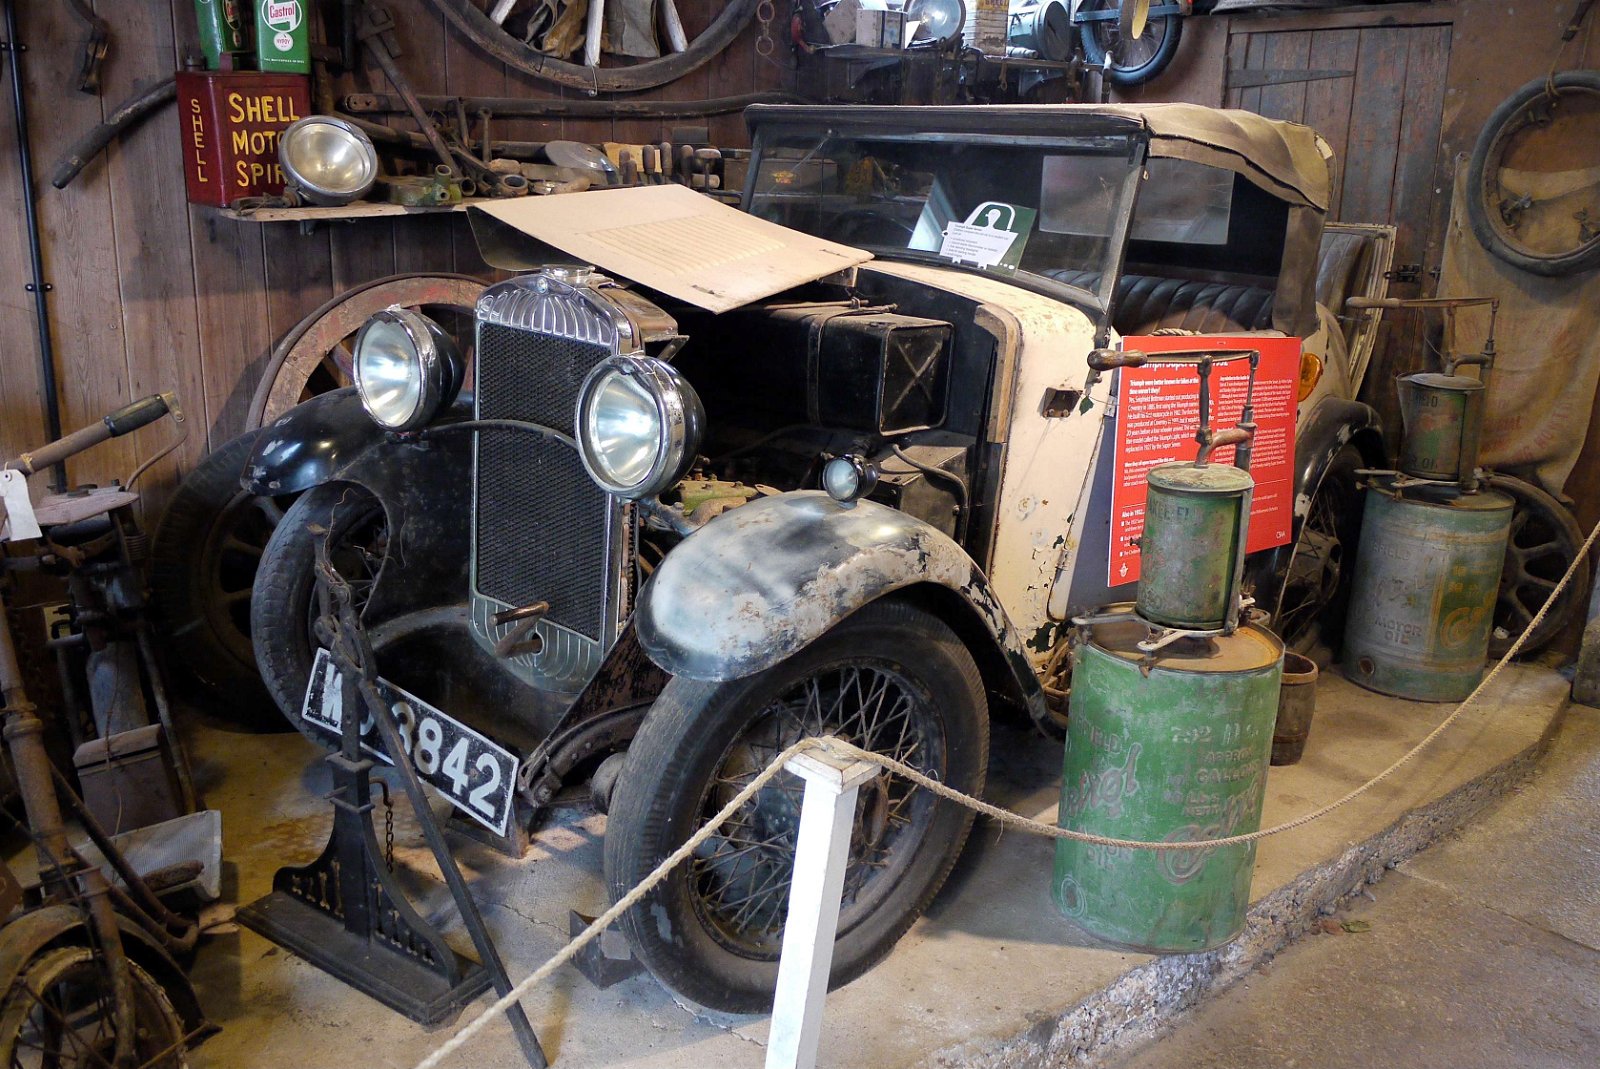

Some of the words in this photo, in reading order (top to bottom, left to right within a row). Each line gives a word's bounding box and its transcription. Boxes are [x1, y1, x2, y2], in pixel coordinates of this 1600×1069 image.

[269, 3, 295, 19] Castrol
[228, 92, 300, 123] SHELL
[191, 98, 208, 183] SHELL
[232, 129, 285, 155] MOT
[236, 160, 289, 187] SPIR
